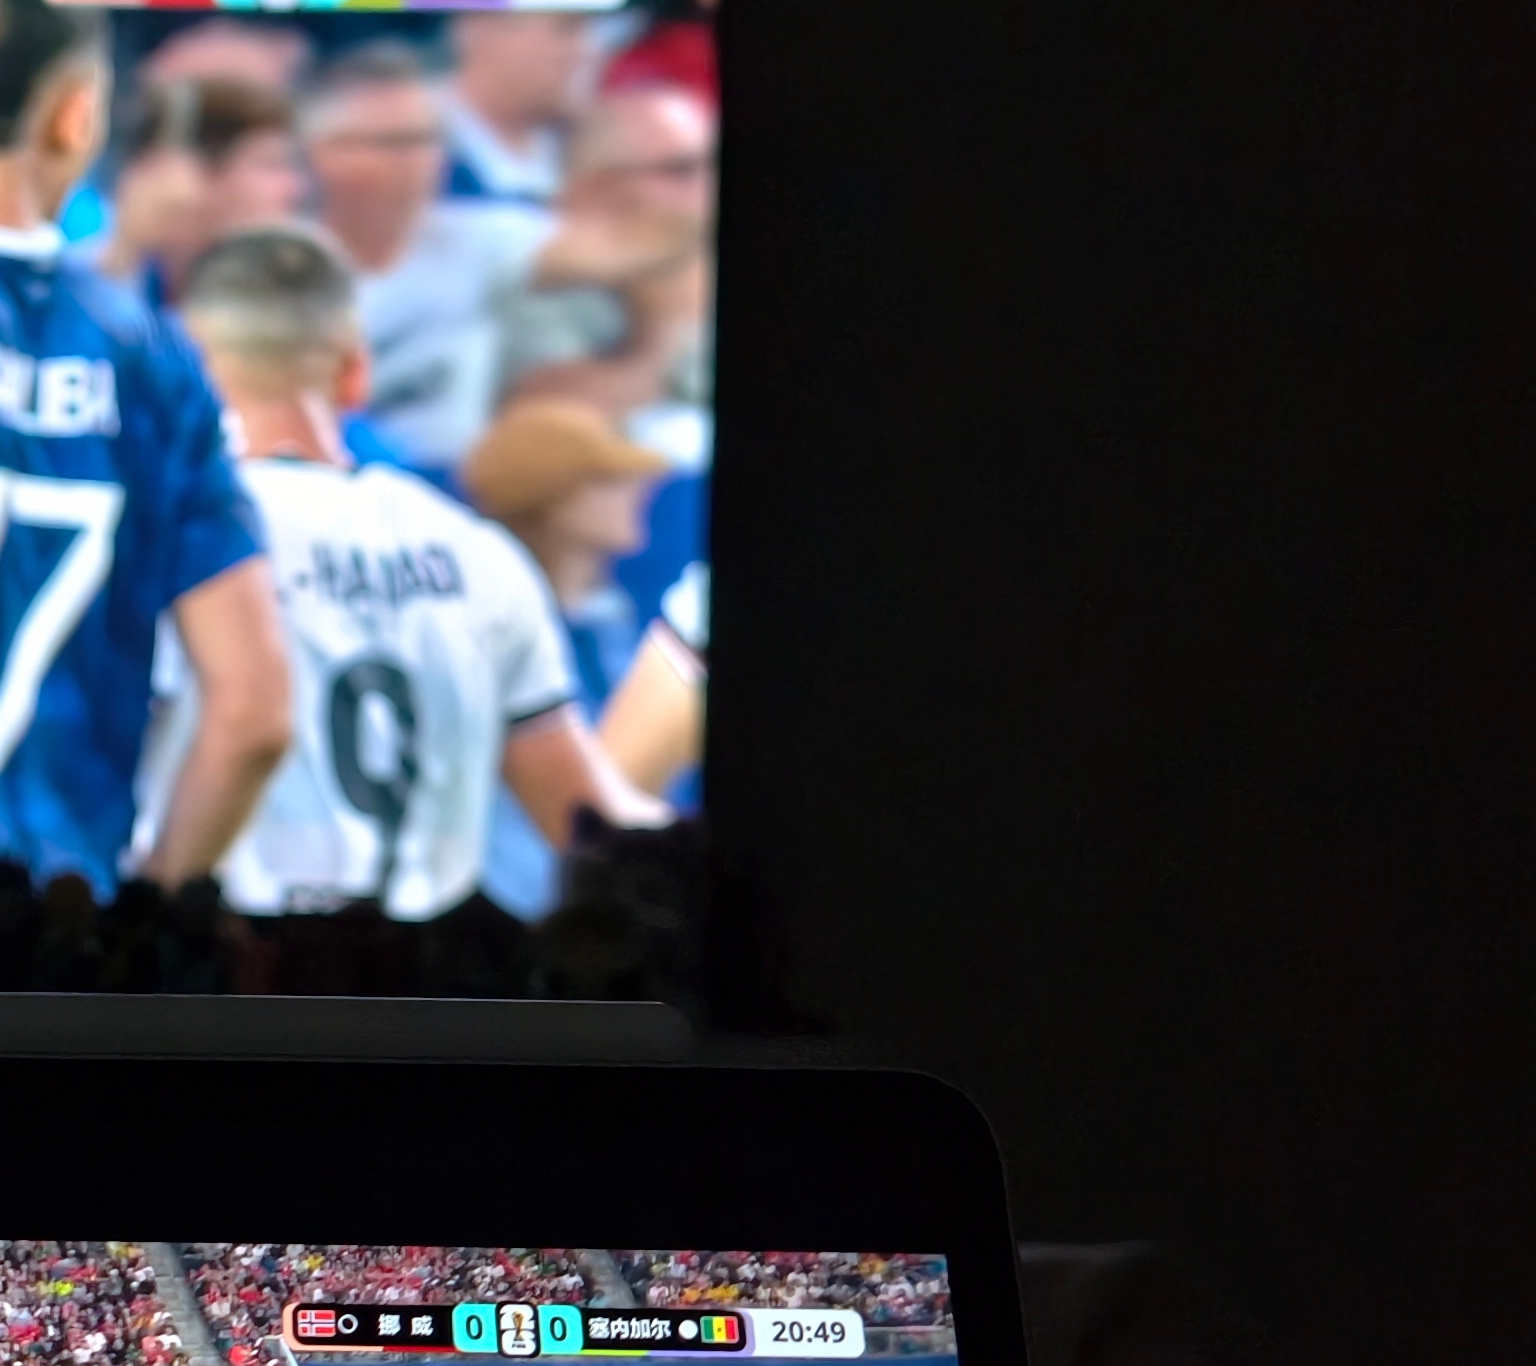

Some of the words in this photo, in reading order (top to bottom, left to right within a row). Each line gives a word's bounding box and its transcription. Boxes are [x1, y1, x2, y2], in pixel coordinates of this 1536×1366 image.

[465, 1315, 482, 1340] 0
[550, 1317, 567, 1341] 0
[771, 1321, 846, 1343] 20:49
